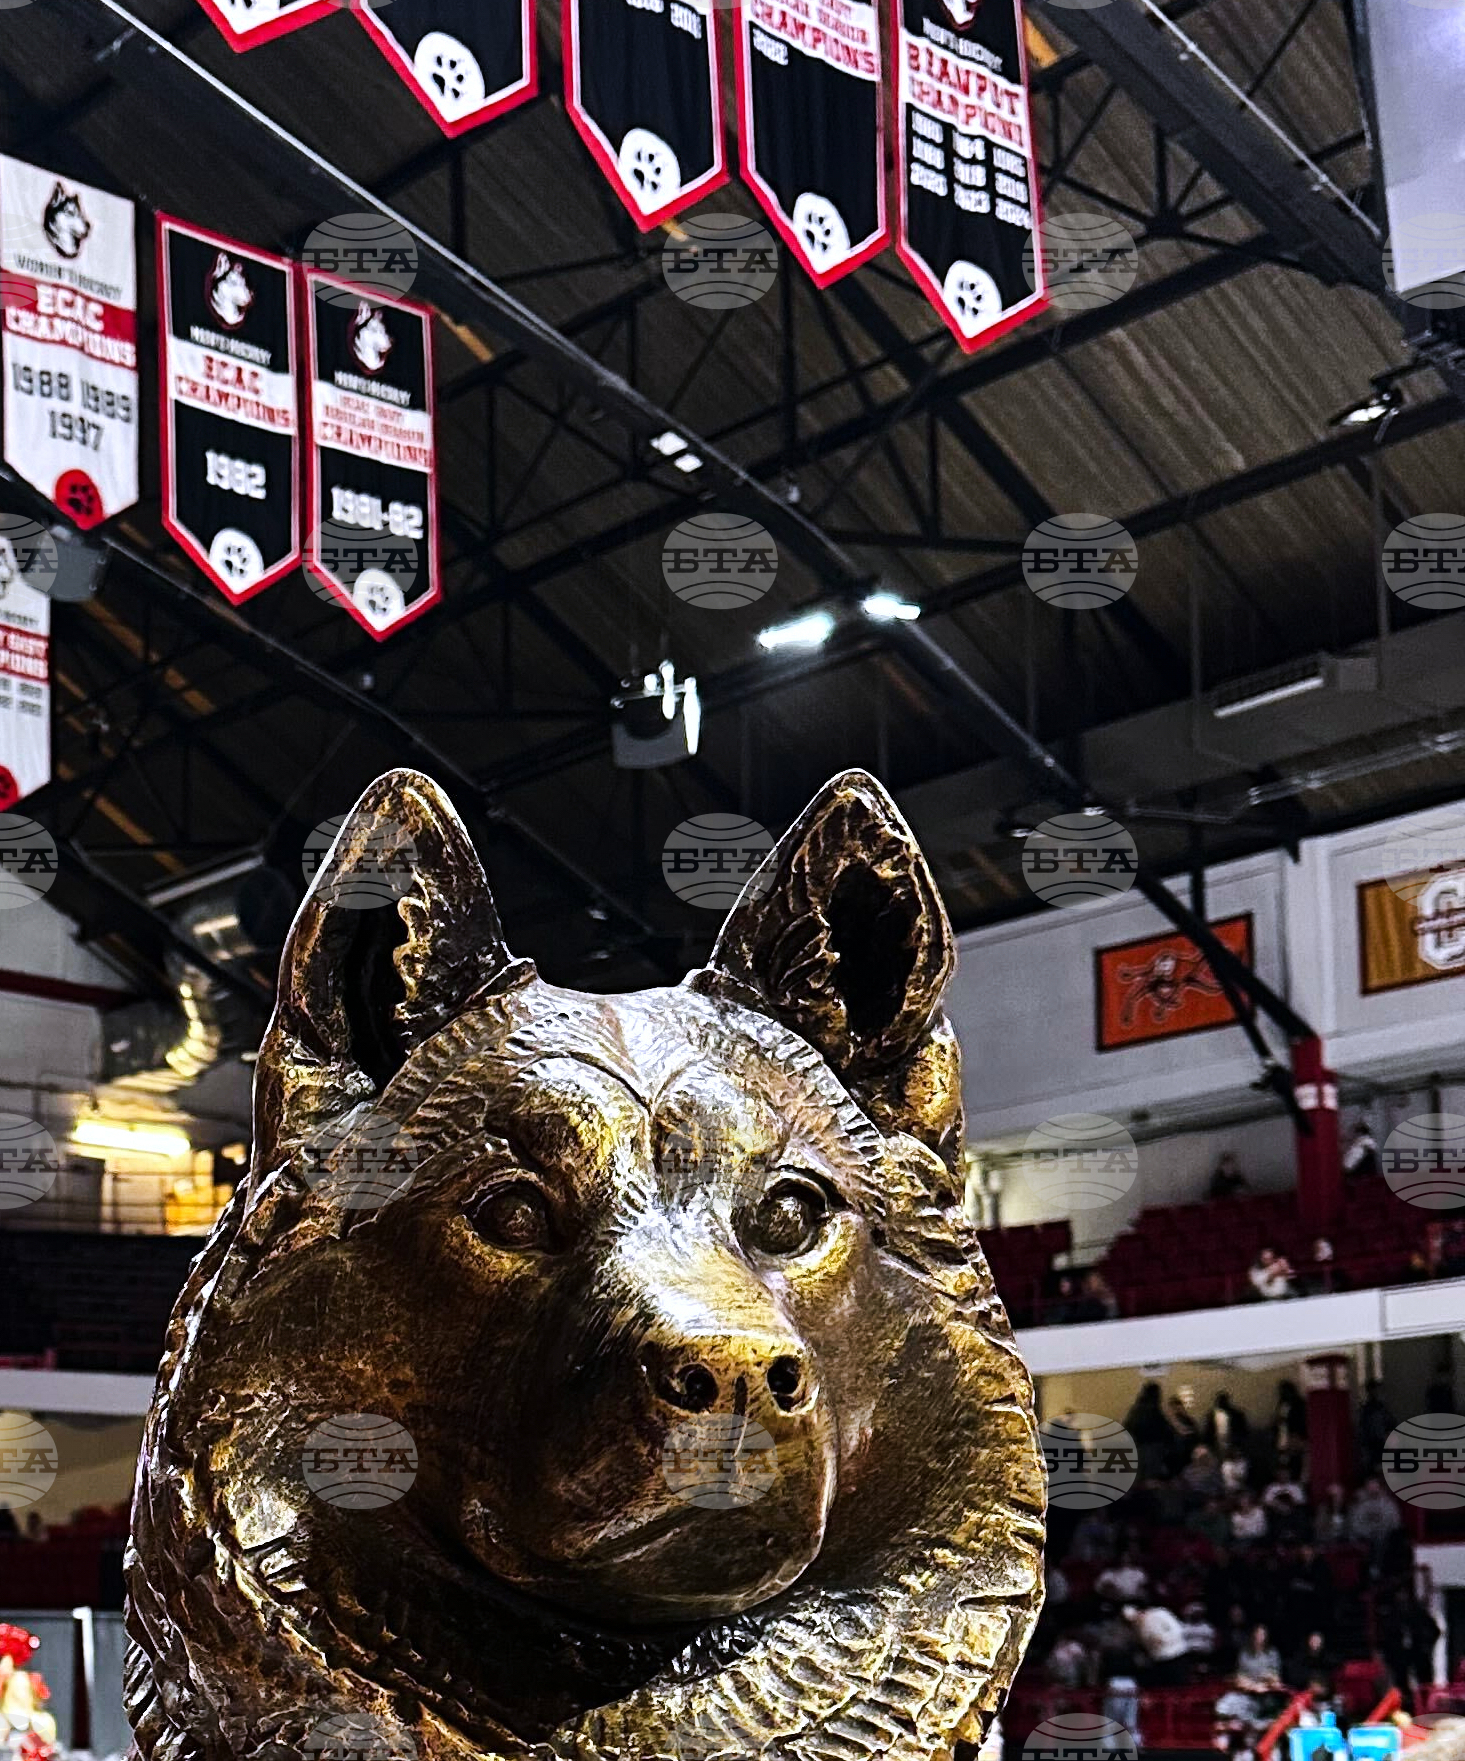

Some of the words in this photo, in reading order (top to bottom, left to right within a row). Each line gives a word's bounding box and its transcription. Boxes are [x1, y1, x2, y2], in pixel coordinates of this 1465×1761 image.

[907, 41, 1020, 116] BEANPOT
[36, 283, 104, 332] ECAC
[6, 305, 136, 369] CHAMPIONS
[12, 362, 72, 402] 1988
[204, 354, 262, 397] ECAC
[175, 374, 291, 428] CHAMPIONS
[49, 409, 103, 452] 1997
[205, 449, 267, 500] 1982
